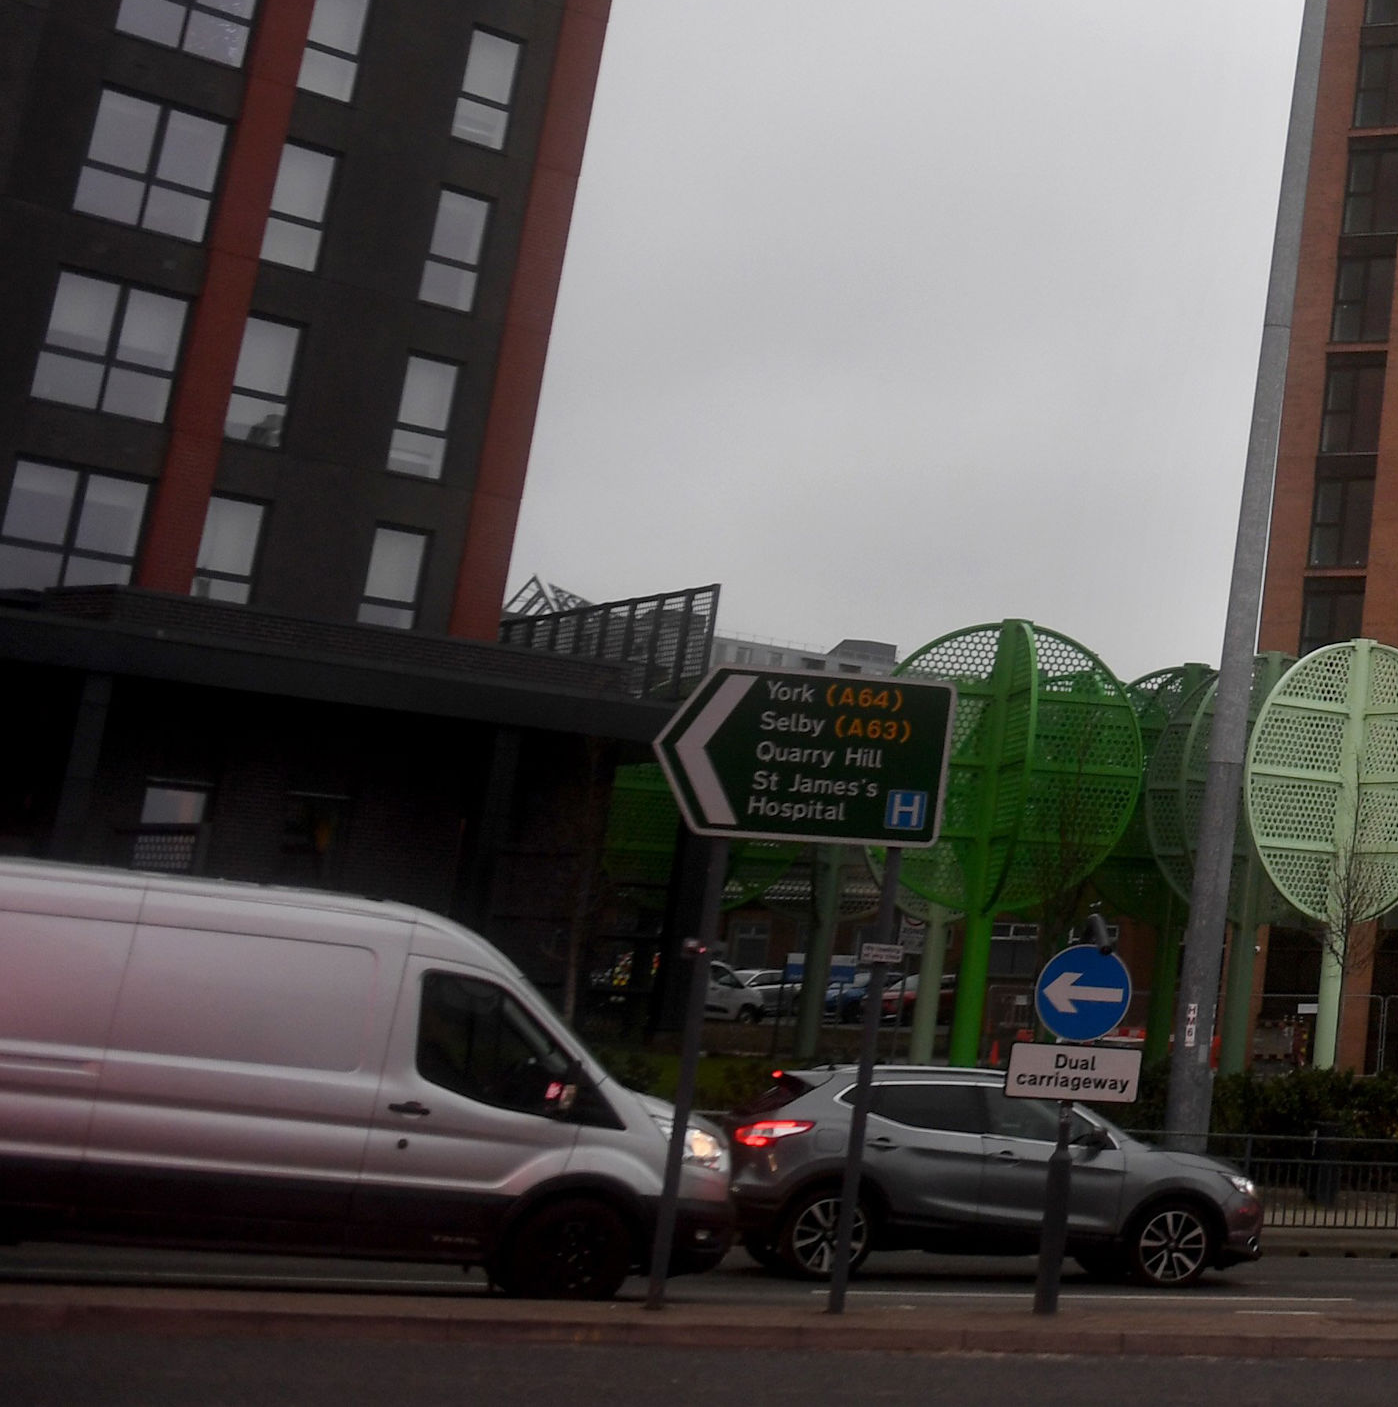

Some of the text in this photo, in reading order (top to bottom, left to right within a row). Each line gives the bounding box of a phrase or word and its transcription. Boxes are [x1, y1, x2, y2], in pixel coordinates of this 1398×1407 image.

[767, 680, 903, 712] York (A64)
[760, 711, 912, 743] Selby (A63)
[756, 741, 883, 768] Quarry Hill
[752, 770, 878, 798] St James's
[747, 796, 846, 822] Hospital
[890, 794, 922, 828] H
[1054, 1053, 1097, 1072] Dual
[1016, 1073, 1130, 1094] carriageway
